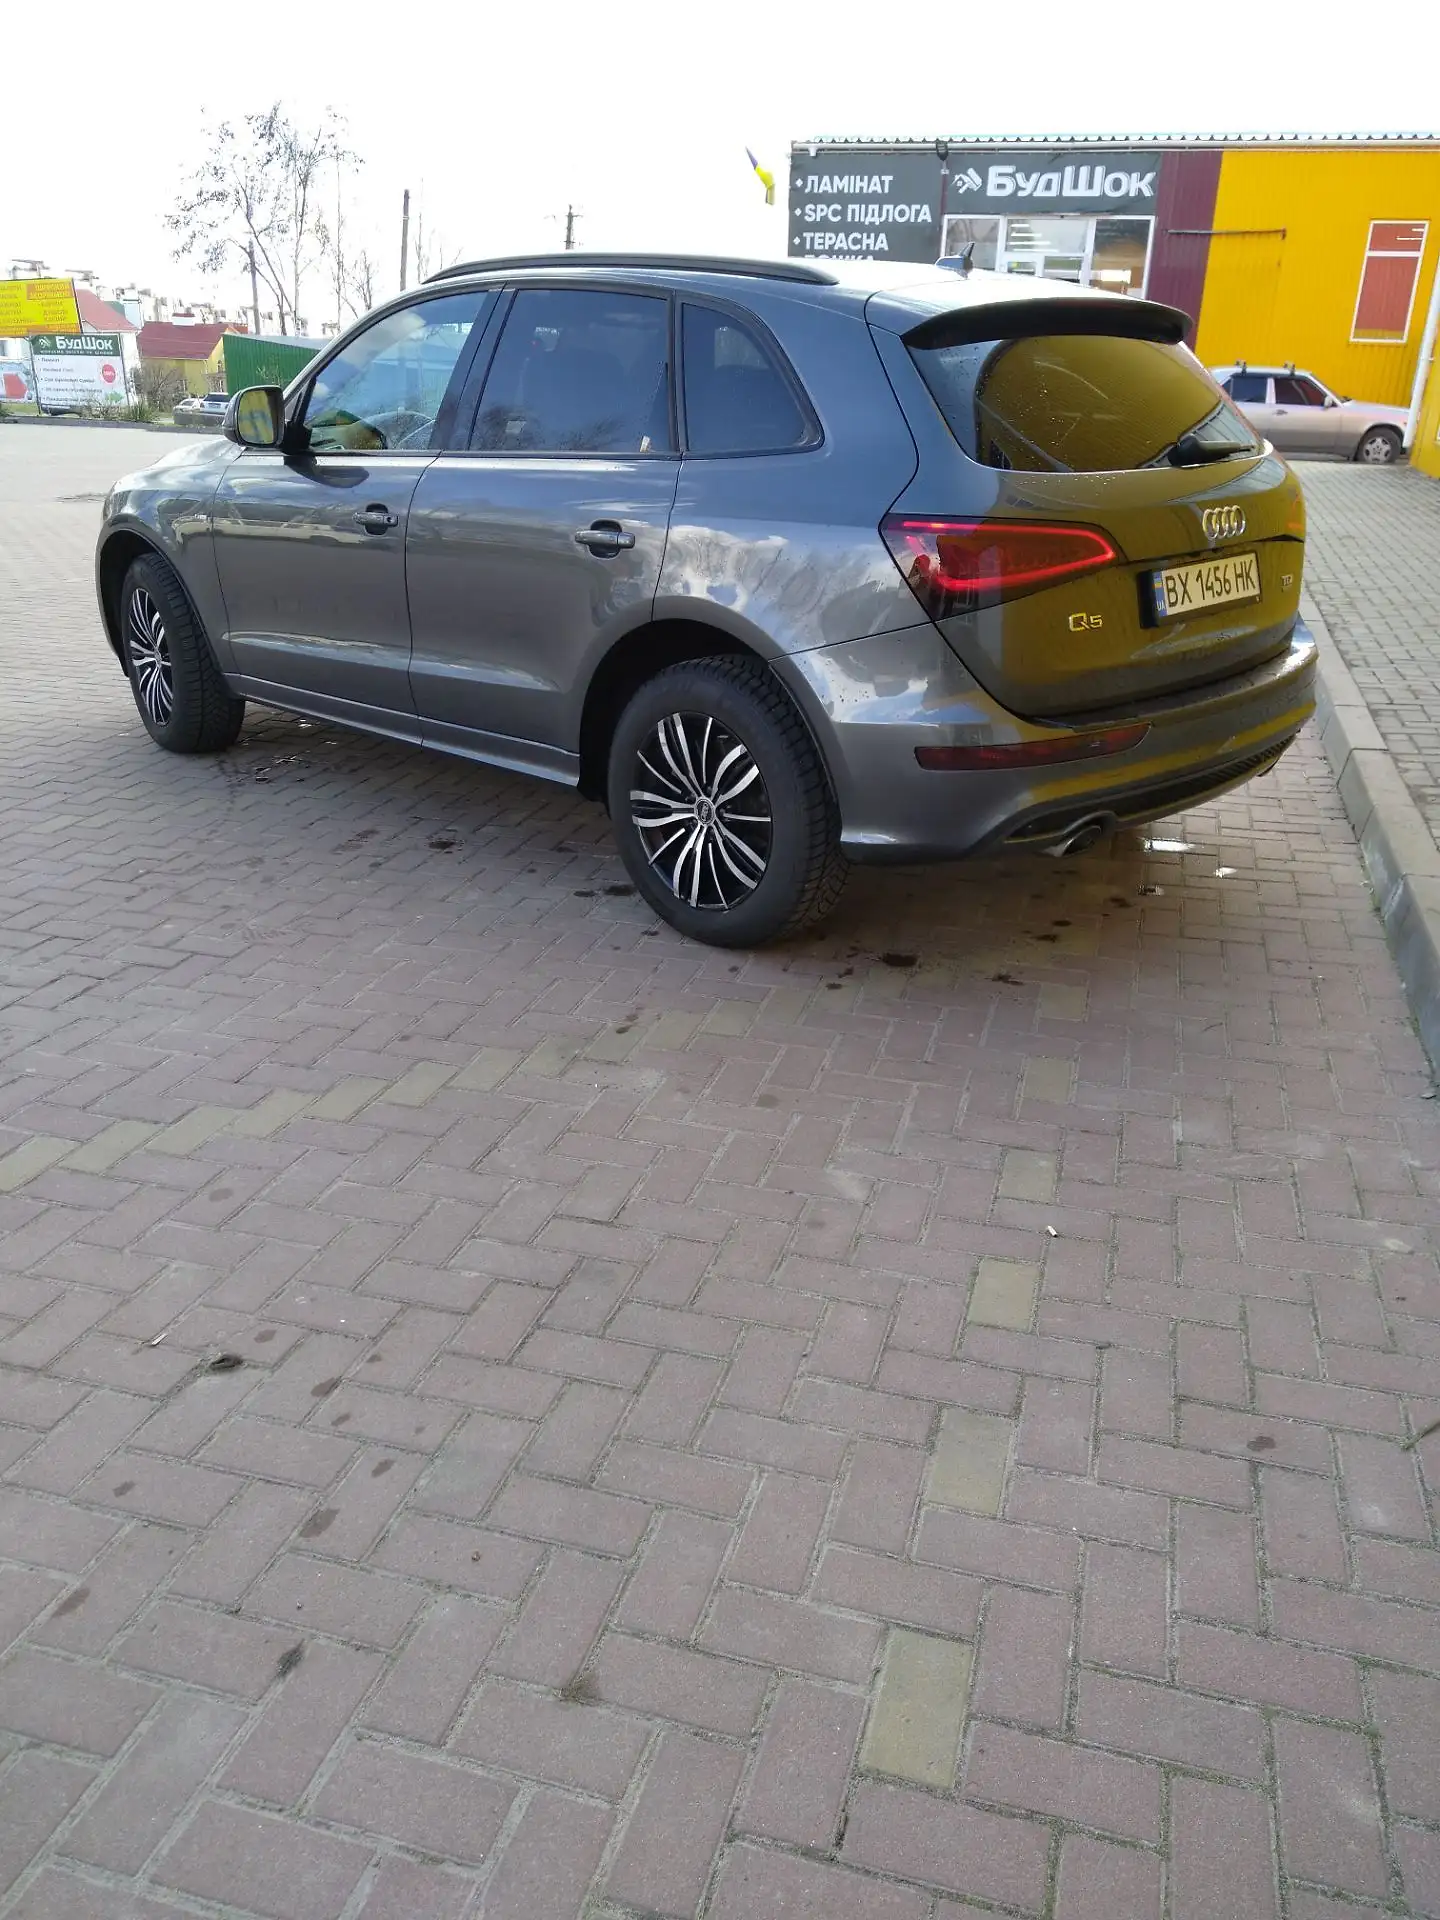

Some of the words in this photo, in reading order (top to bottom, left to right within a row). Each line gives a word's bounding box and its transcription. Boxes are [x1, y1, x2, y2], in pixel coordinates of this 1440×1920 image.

[804, 175, 893, 195] ЛАМІНАТ
[985, 165, 1157, 198] БудШок
[804, 204, 842, 223] SPC
[847, 204, 932, 225] ПІДЛОГА
[803, 232, 889, 251] ТЕРАСНА
[55, 335, 113, 350] БудШок
[1165, 571, 1193, 608] BX
[1196, 564, 1232, 601] 1456
[1233, 559, 1256, 593] HK
[1068, 612, 1103, 632] Q5
